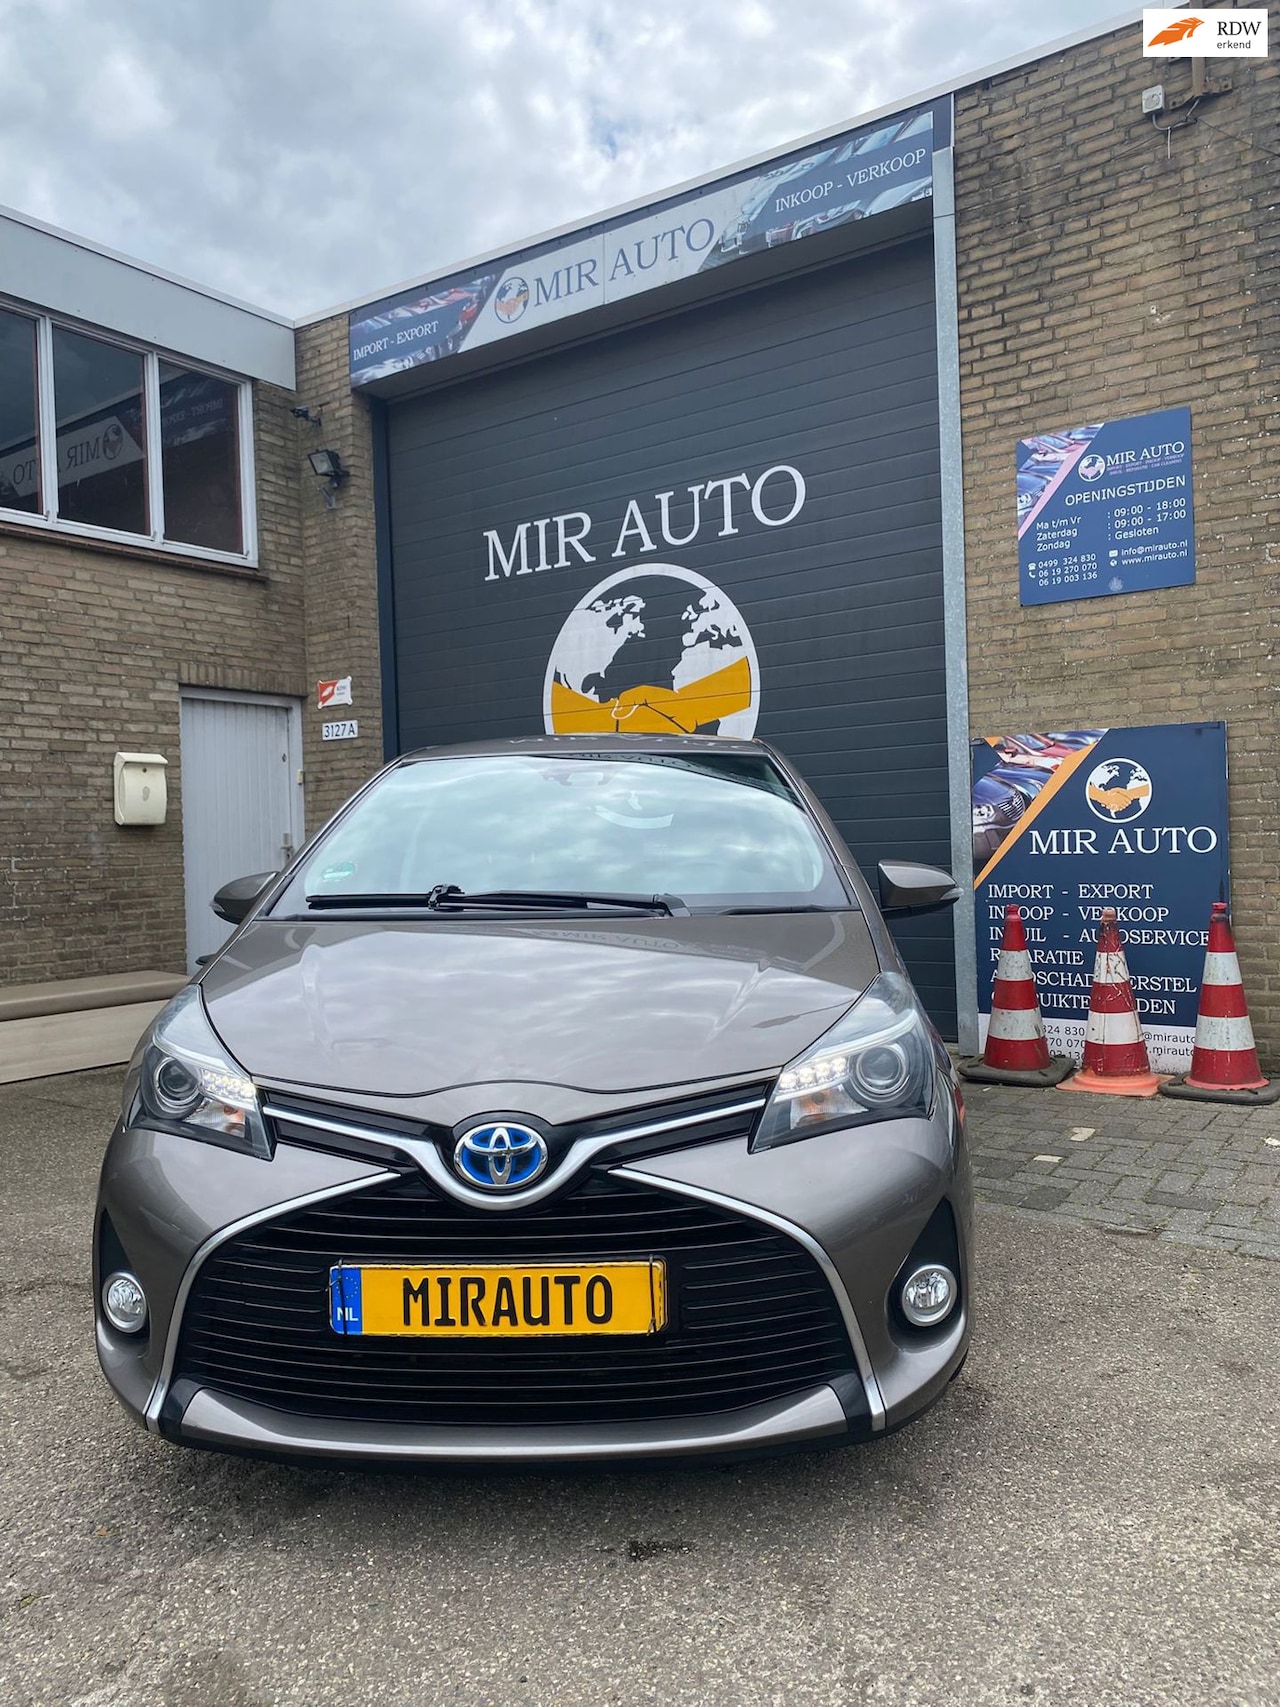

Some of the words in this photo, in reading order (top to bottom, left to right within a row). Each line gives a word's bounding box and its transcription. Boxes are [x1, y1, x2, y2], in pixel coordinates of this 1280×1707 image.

[775, 181, 834, 213] INKOOP
[846, 148, 926, 188] VERKOOP
[533, 258, 599, 307] MIR
[608, 218, 715, 281] AUTO
[353, 337, 391, 362] IMPORT
[396, 321, 439, 344] EXPORT
[1106, 450, 1136, 467] MIR
[1140, 441, 1185, 460] AUTO
[1065, 475, 1186, 506] OPENINGSTIJDEN
[483, 512, 596, 581] MIR
[611, 464, 807, 558] AUTO
[1036, 522, 1049, 530] Ma
[1052, 518, 1068, 529] t/m
[1070, 516, 1082, 524] Vr
[1114, 504, 1143, 518] 09:00
[1156, 497, 1186, 511] 18:00
[1036, 528, 1078, 541] Zaterdag
[1114, 516, 1144, 529] 09:00
[1157, 509, 1186, 522] 17:00
[1037, 540, 1071, 552] Zondag
[1115, 526, 1159, 540] Gesloten
[1121, 539, 1188, 556] info@mirauto.nl
[1038, 559, 1058, 568] 0499
[1063, 556, 1078, 565] 324
[1080, 553, 1096, 562] 830
[1121, 549, 1188, 565] www.mirauto.nl
[1038, 569, 1049, 577] 06
[1052, 567, 1061, 575] 19
[1064, 565, 1079, 574] 270
[1082, 562, 1097, 571] 070
[1064, 574, 1079, 583] 003
[1083, 571, 1098, 580] 136
[324, 723, 347, 738] 3127
[348, 722, 356, 736] A
[1029, 828, 1099, 855] MIR
[1107, 826, 1218, 855] AUTO
[988, 883, 1054, 899] IMPORT
[1078, 883, 1154, 900] EXPORT
[988, 906, 1054, 921] INOOP
[1078, 906, 1169, 922] VEKOOP
[1079, 928, 1209, 946] AUOSERVICE
[1064, 1026, 1085, 1036] 830
[1046, 1037, 1062, 1047] 70
[402, 1274, 614, 1327] MIRAUTO
[336, 1306, 358, 1321] NL
